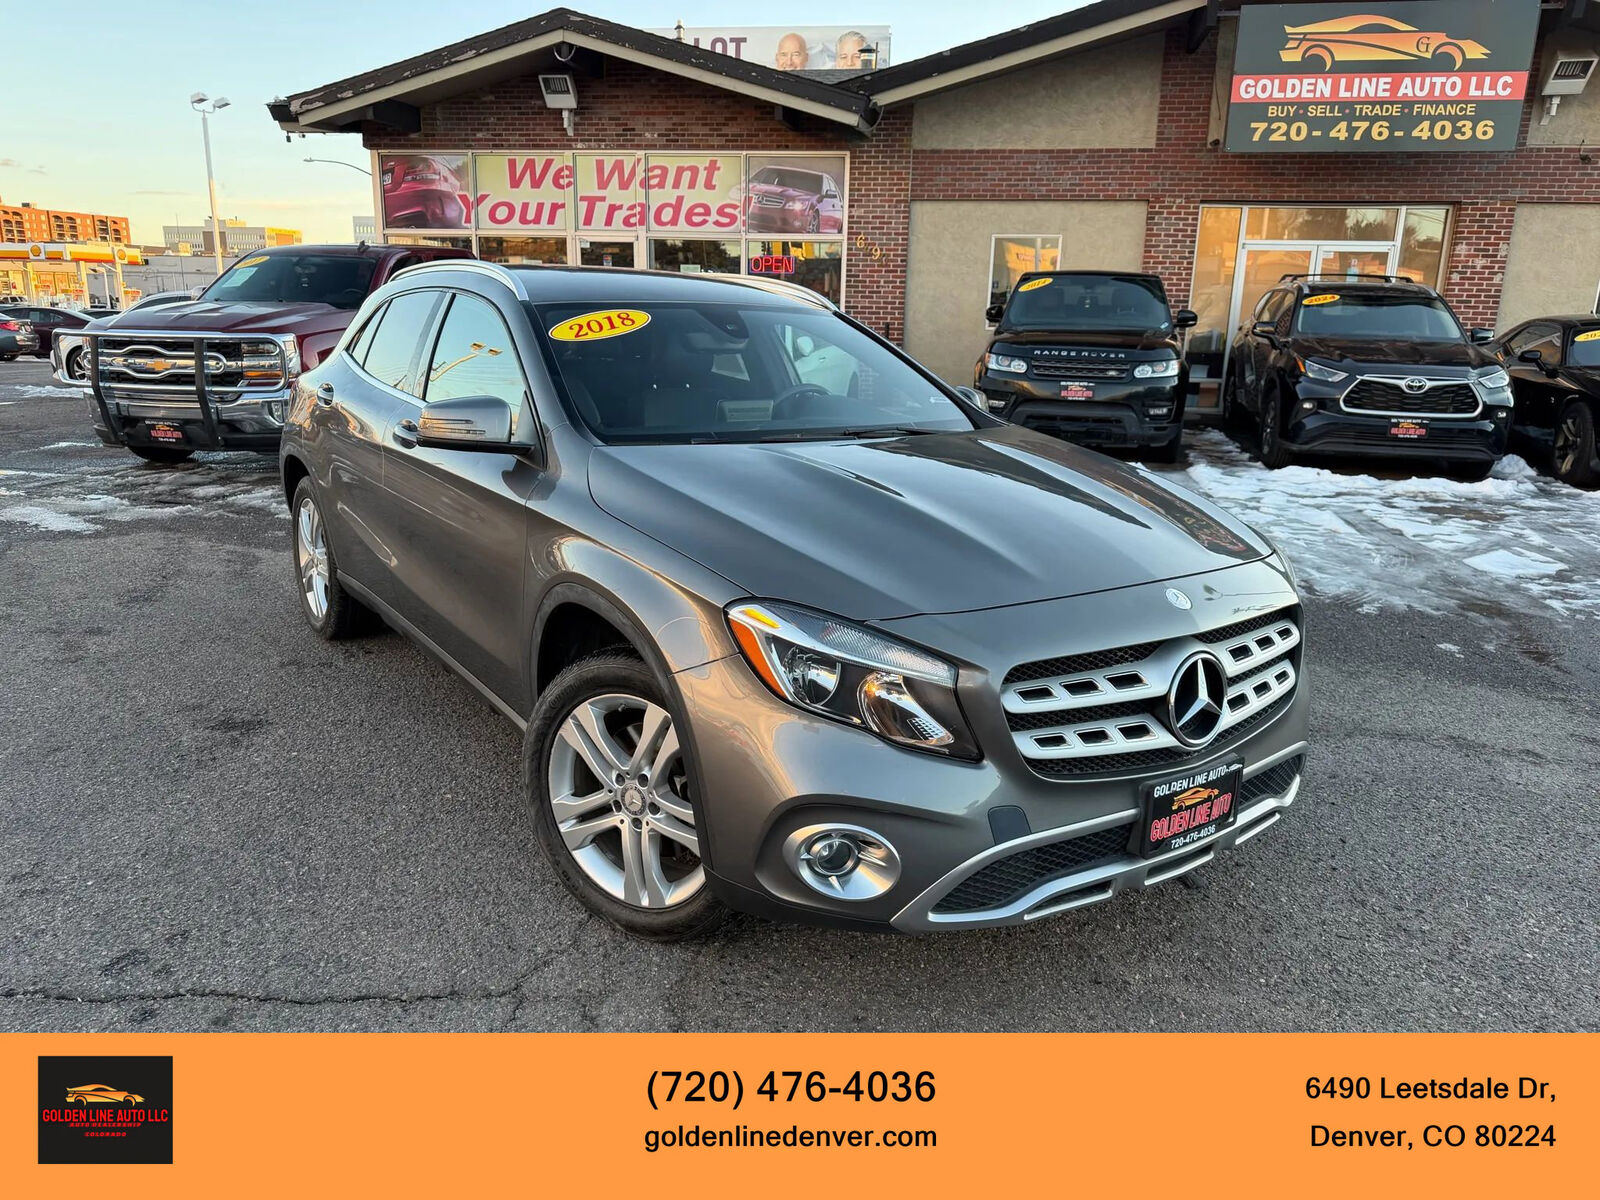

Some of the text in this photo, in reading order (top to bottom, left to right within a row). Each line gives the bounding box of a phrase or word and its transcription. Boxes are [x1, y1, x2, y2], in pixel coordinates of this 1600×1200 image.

[1239, 75, 1513, 99] GOLDEN LINE AUTO LLC
[1267, 103, 1477, 117] BUY SELL TRADE FINANCE
[507, 157, 722, 192] We Want
[457, 193, 754, 229] Your Trades!
[751, 256, 793, 273] OPEN
[569, 312, 636, 338] 2018
[1154, 778, 1188, 798] GOLDEN
[1189, 772, 1207, 788] LINE
[1150, 793, 1232, 841] GOLDEN LINE AUTO
[1171, 825, 1216, 849] 720-476-4036
